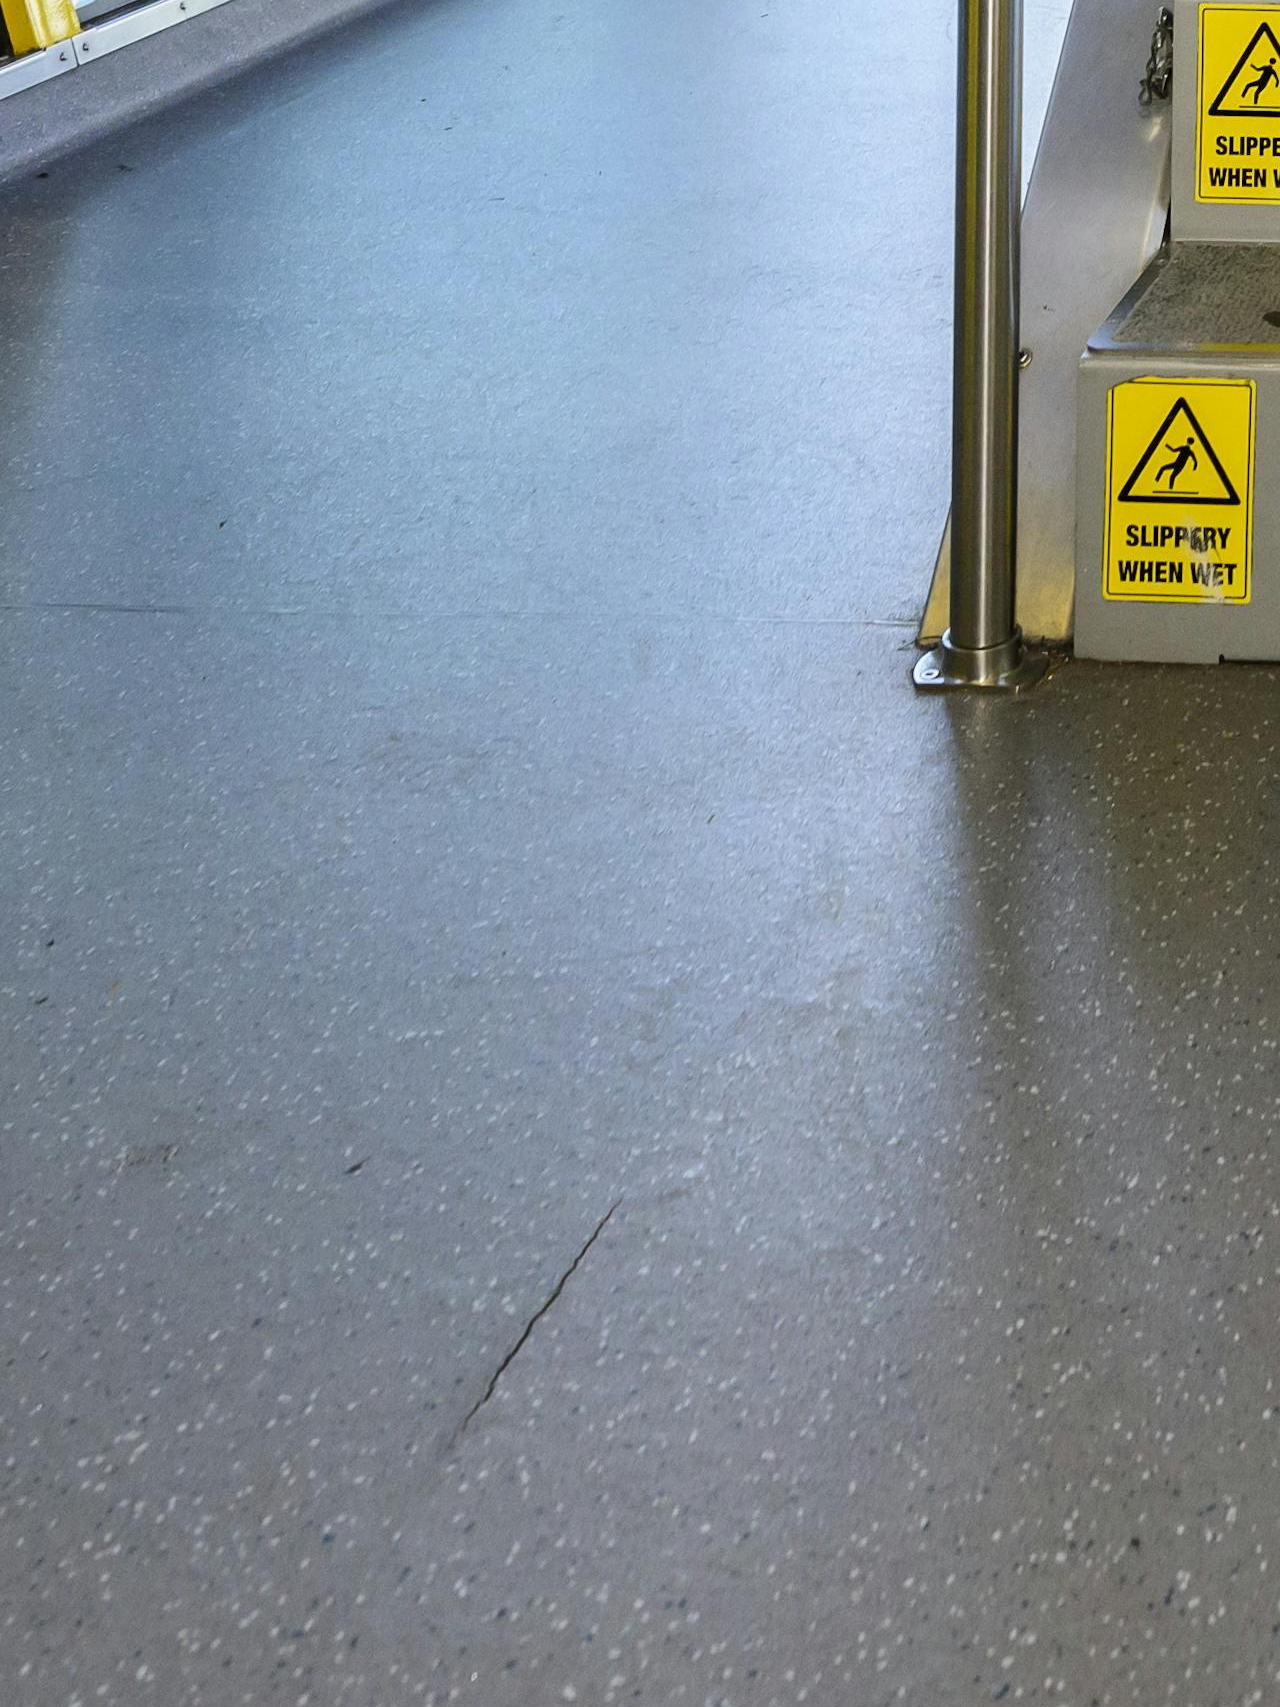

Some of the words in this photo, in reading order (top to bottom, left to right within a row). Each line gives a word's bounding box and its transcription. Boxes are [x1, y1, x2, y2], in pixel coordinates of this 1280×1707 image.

[1209, 168, 1267, 187] WHEN
[1118, 560, 1183, 583] WHEN
[1191, 562, 1238, 586] WET
